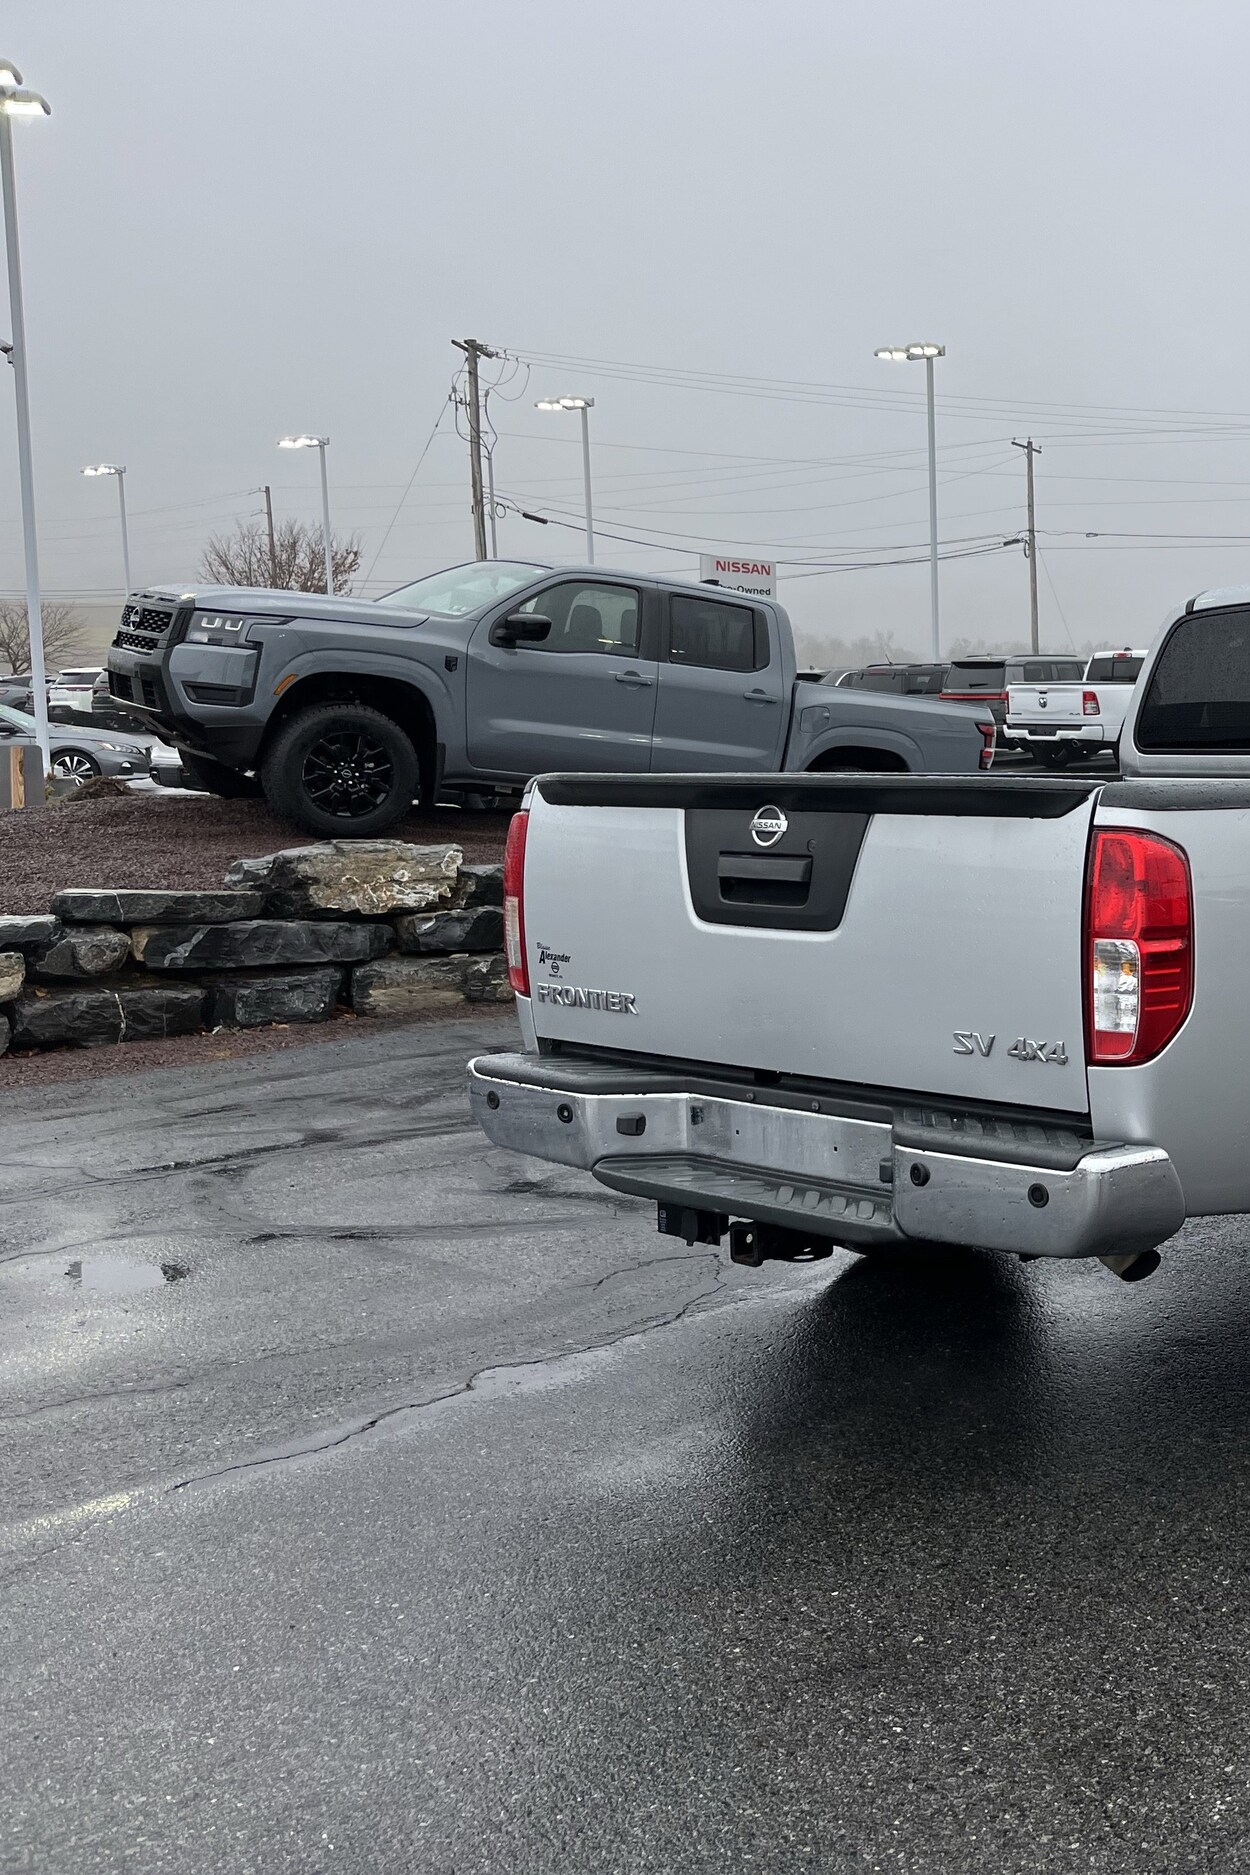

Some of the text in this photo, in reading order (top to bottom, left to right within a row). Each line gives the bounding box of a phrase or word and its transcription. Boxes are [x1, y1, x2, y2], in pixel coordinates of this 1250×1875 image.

[715, 560, 771, 576] NISSAN
[752, 821, 782, 830] NISSAN
[539, 950, 571, 964] Alexander
[537, 983, 640, 1015] FRONTIER
[953, 1031, 996, 1057] SV
